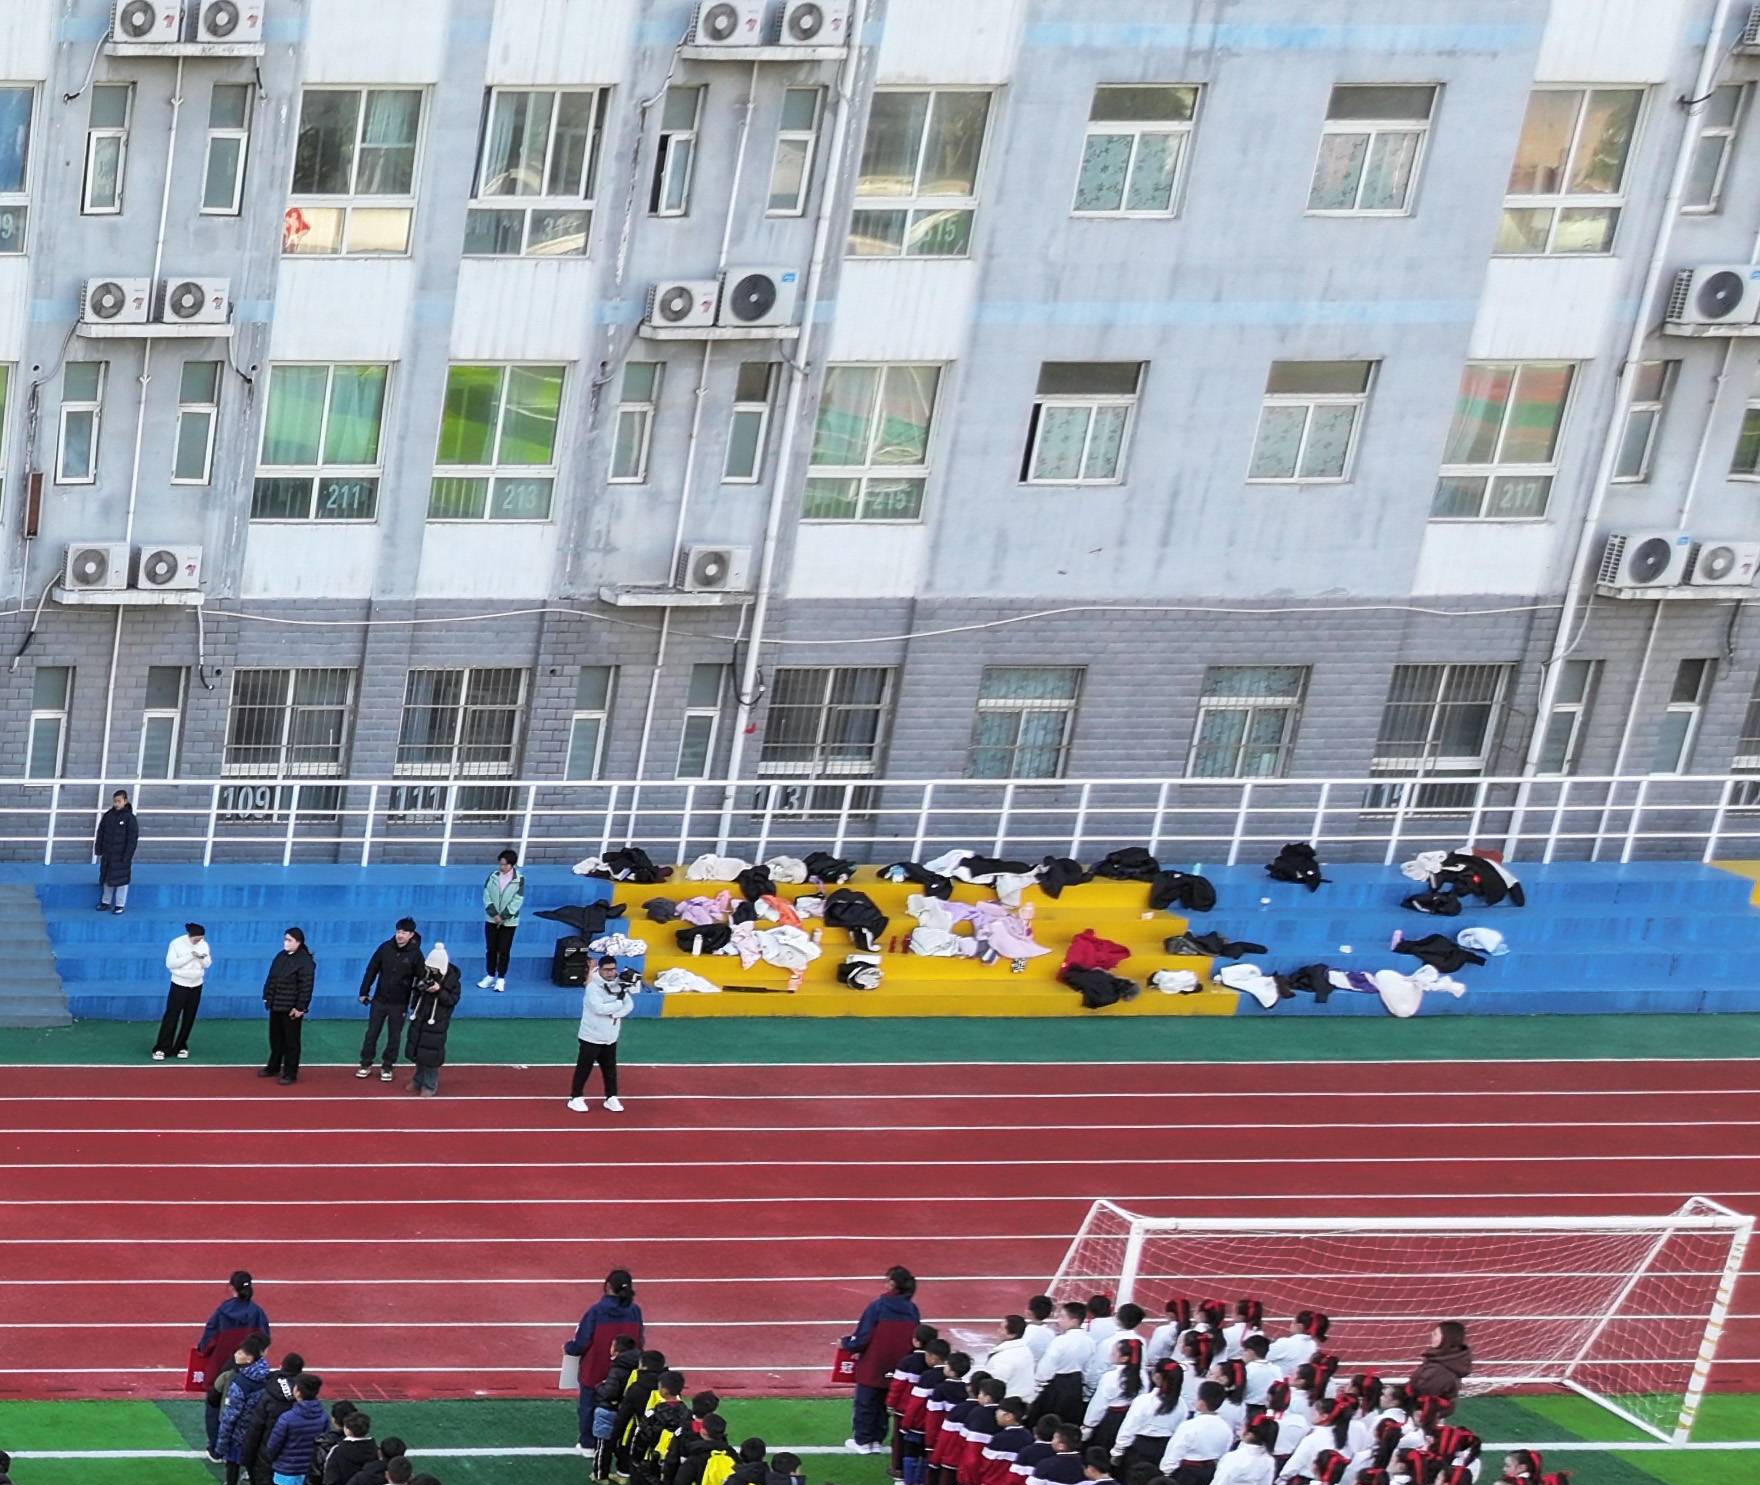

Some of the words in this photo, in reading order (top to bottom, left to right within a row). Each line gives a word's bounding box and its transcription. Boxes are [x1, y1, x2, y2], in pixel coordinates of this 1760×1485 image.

[327, 484, 361, 509] 211
[503, 484, 539, 509] 213
[1500, 483, 1536, 508] 217
[223, 786, 271, 818] 109
[397, 786, 440, 817] 111
[754, 785, 801, 815] 13
